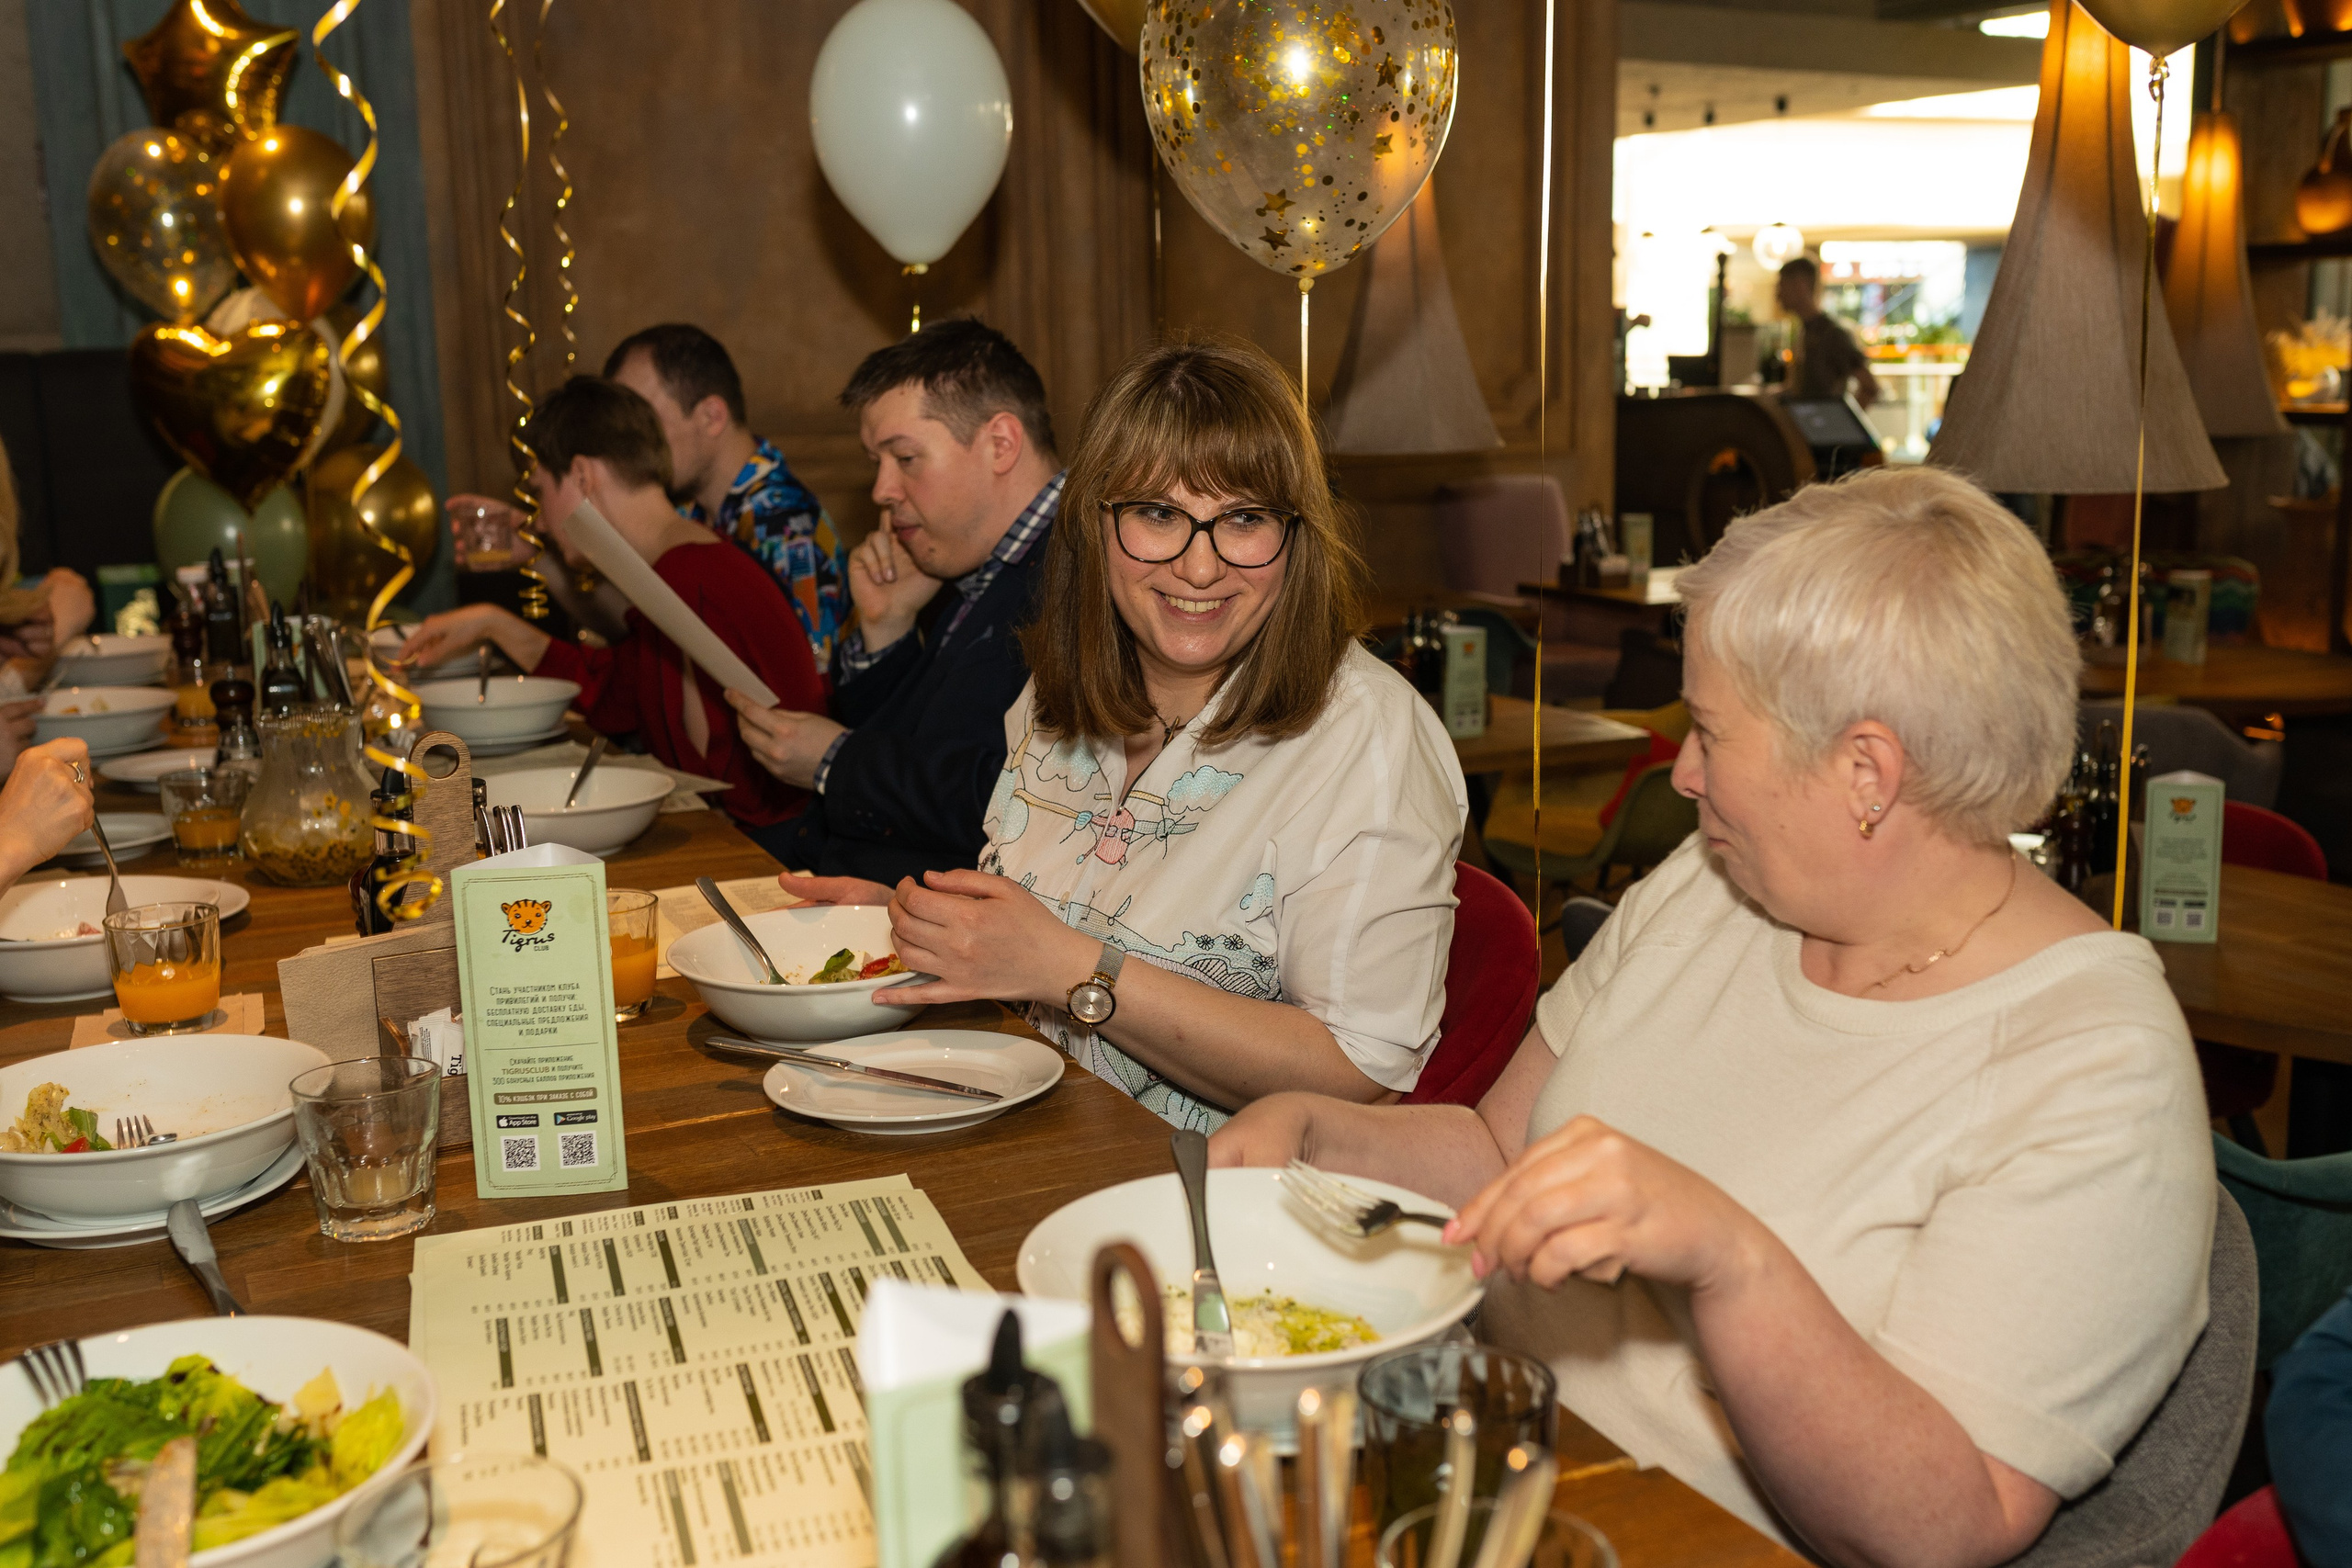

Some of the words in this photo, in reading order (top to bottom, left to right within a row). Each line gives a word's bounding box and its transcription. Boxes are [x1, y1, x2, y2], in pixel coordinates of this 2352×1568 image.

[502, 929, 555, 953] Tigrus
[558, 983, 580, 991] КЛУБА
[496, 994, 539, 1005] ПРИВИЛЕГИЙ
[486, 1008, 529, 1016] БЕСПЛАТНУЮ
[532, 1005, 566, 1015] ДОСТАВКУ
[486, 1018, 536, 1027] СПЕЦИАЛЬНЫЕ
[537, 1014, 589, 1024] ПРЕДЛОЖЕНИЯ
[526, 1027, 558, 1036] ПОДАРКИ
[502, 1066, 550, 1075] TIGRUSCLUB
[498, 1095, 512, 1103] 10%
[575, 1089, 594, 1098] СОБОЙ
